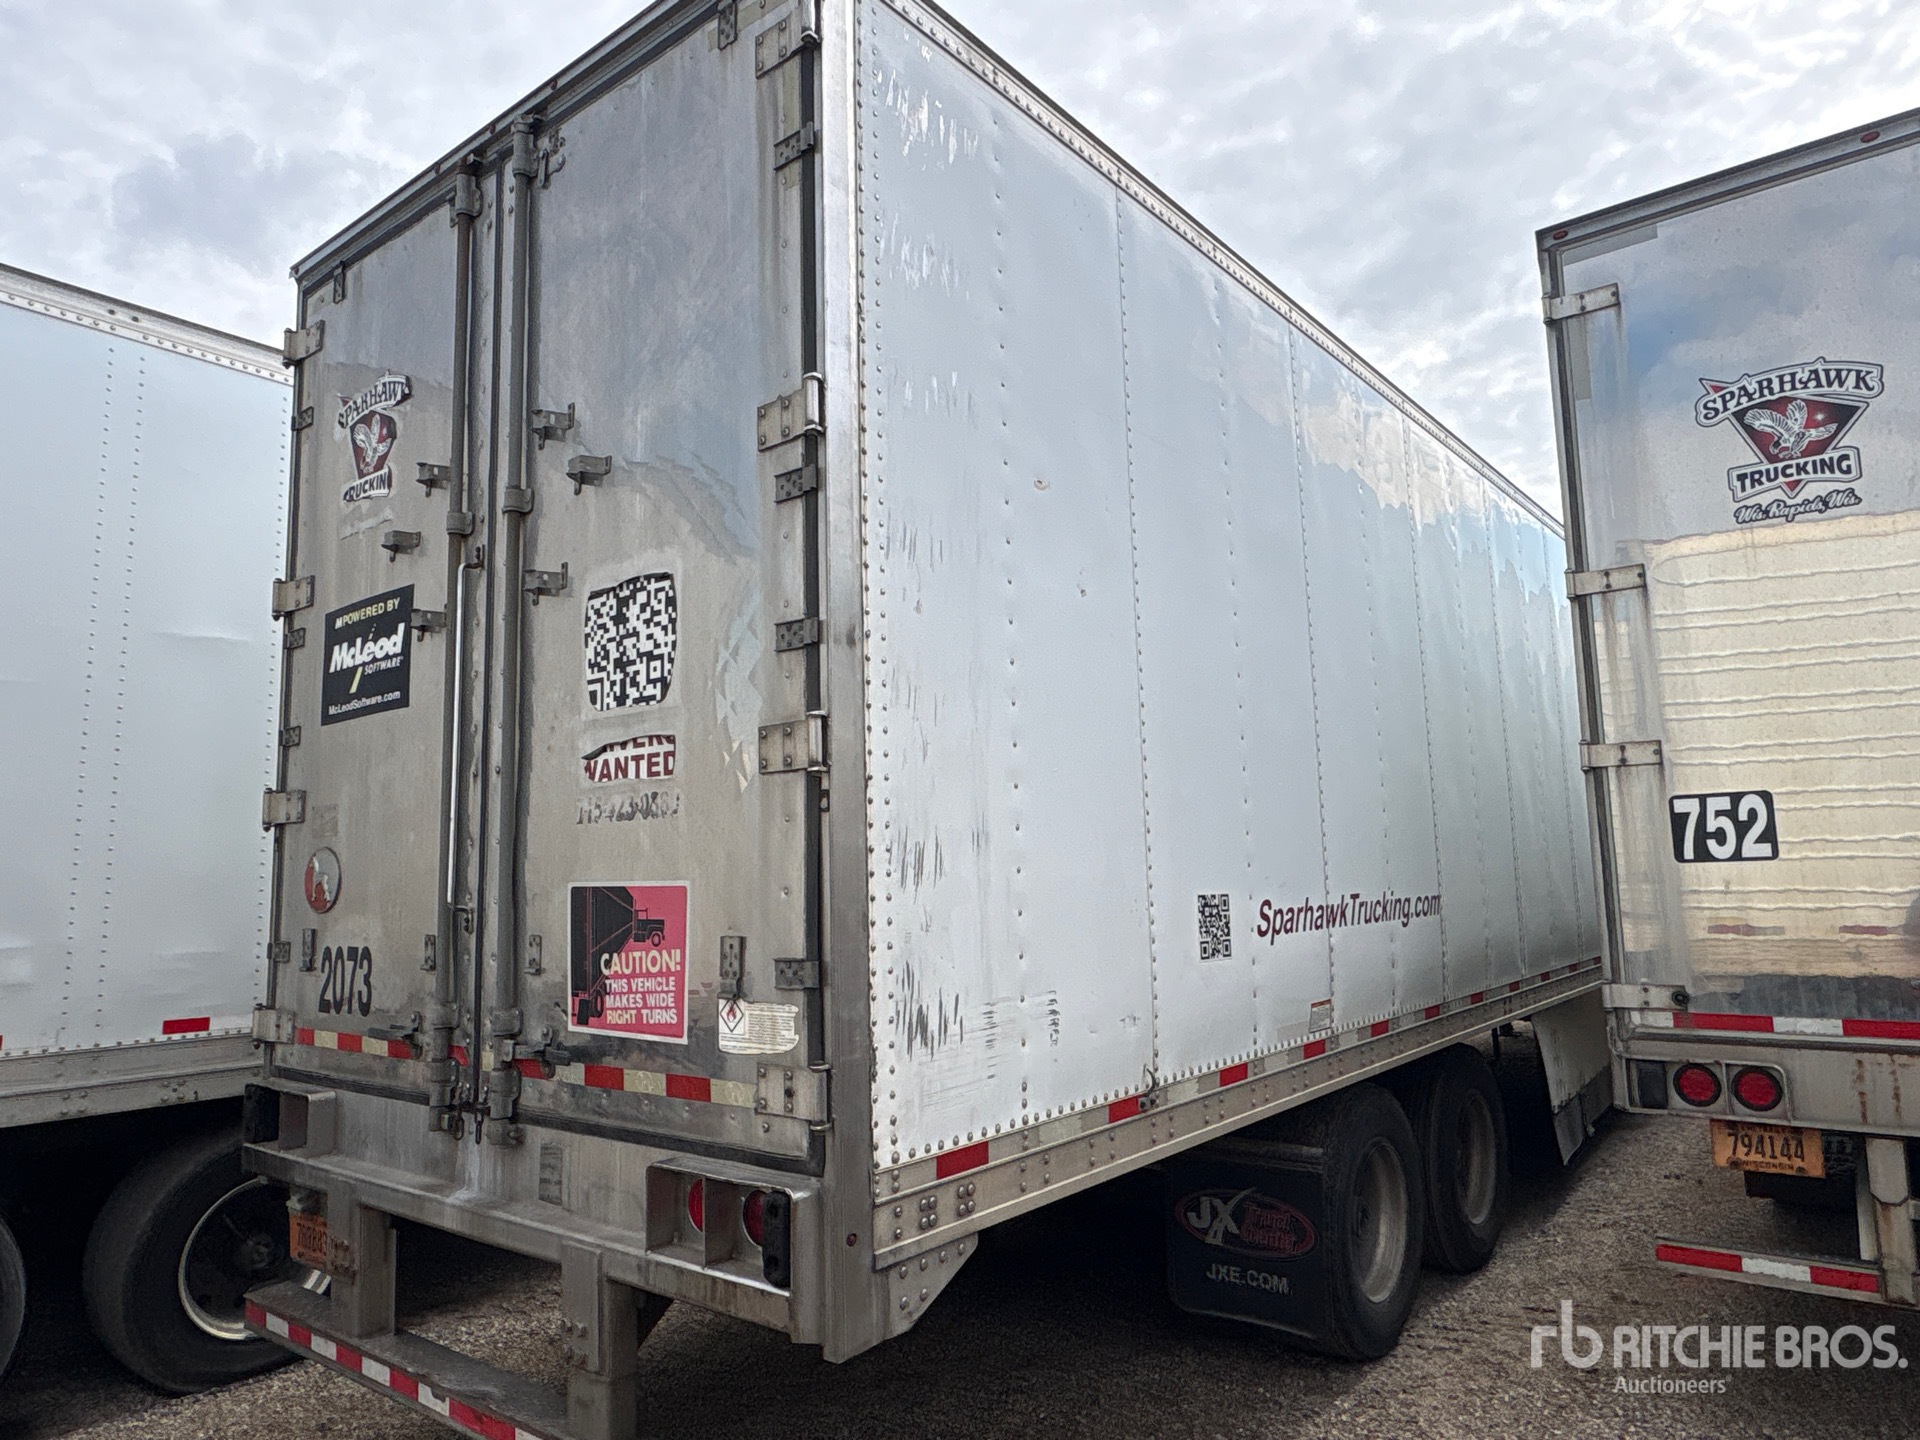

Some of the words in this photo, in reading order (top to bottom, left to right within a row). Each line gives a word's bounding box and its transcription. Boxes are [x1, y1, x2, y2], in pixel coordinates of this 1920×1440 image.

[1703, 369, 1876, 420] SPARHAWK
[1736, 454, 1853, 493] TRUCKING
[1734, 504, 1767, 524] Wis.
[1766, 497, 1826, 522] Rapids,
[1825, 488, 1862, 509] Wis.
[386, 597, 400, 613] BY
[329, 622, 405, 674] McLeod
[328, 690, 401, 716] McLeodSoftware.com
[1672, 793, 1773, 860] 752
[1257, 891, 1442, 946] SparhawkTrucking.com
[600, 949, 681, 975] CAUTION!
[318, 945, 373, 1017] 2073
[605, 978, 628, 993] THIS
[631, 976, 676, 992] VEHICLE
[606, 993, 643, 1009] MAKES
[646, 992, 675, 1007] WIDE
[606, 1009, 637, 1025] RIGHT
[641, 1008, 678, 1024] TURNS
[1727, 1132, 1805, 1163] 794144
